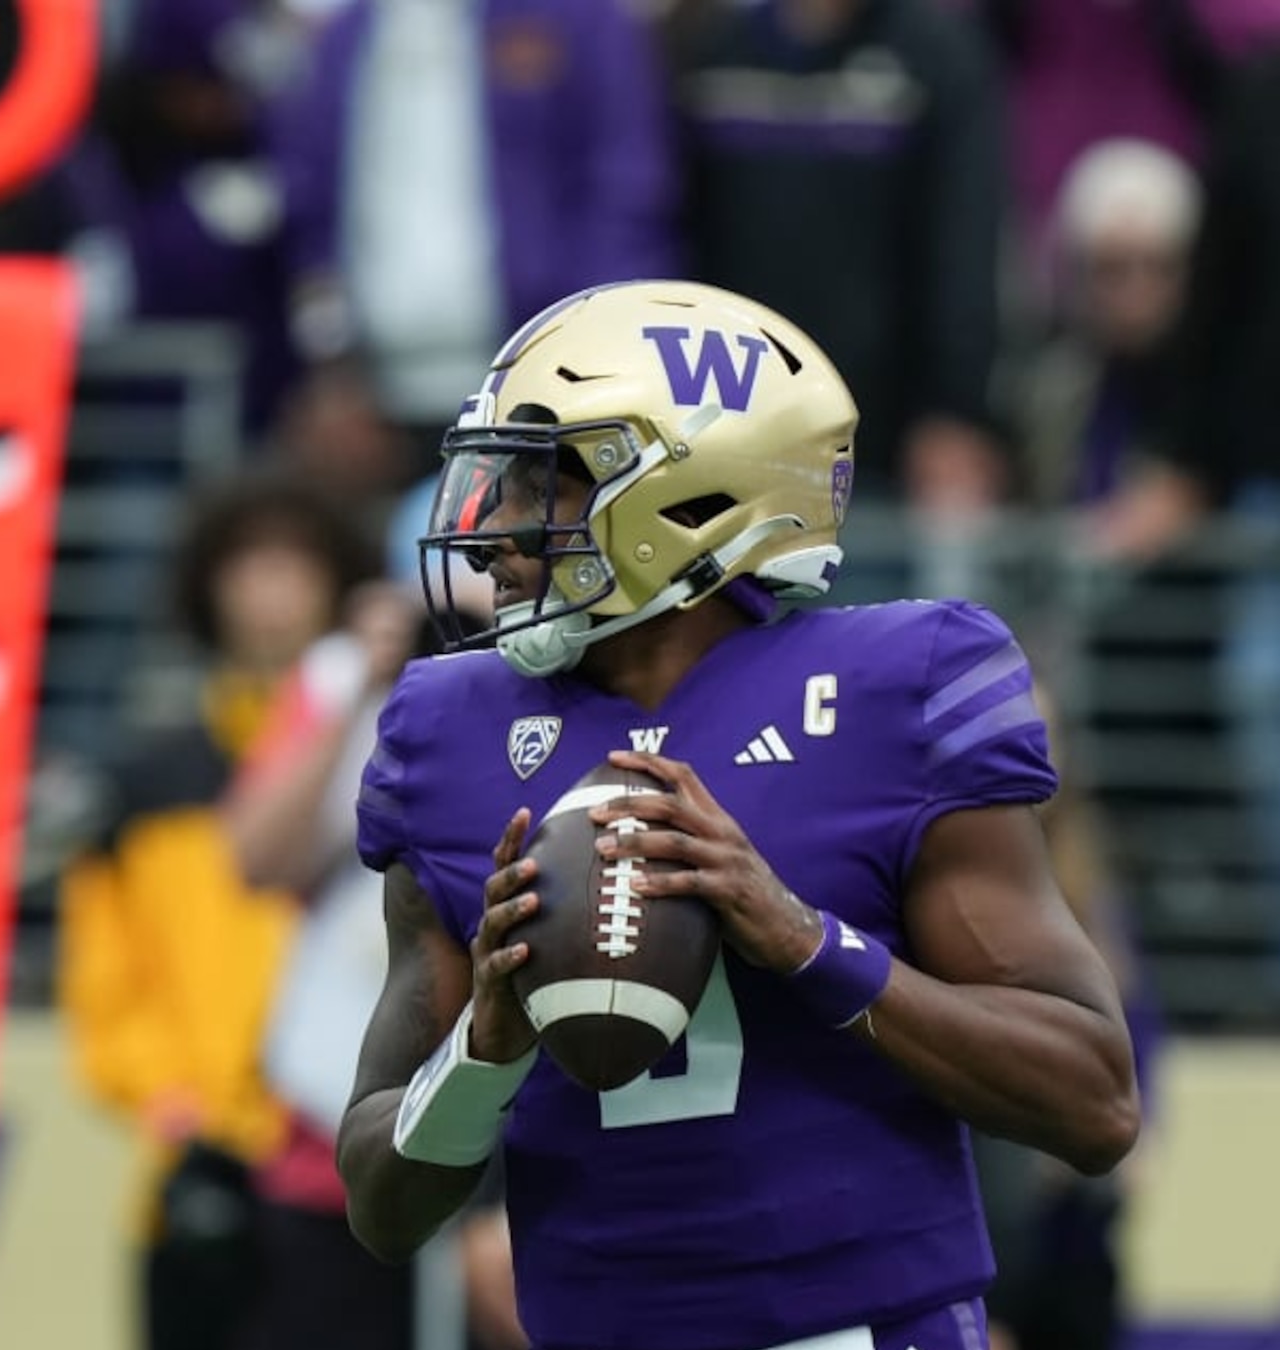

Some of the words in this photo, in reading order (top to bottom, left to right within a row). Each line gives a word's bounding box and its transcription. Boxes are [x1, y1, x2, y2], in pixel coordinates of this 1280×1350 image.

[641, 326, 769, 412] W
[803, 673, 838, 737] C
[511, 718, 559, 752] PAC
[628, 725, 670, 754] W
[515, 741, 542, 765] 12
